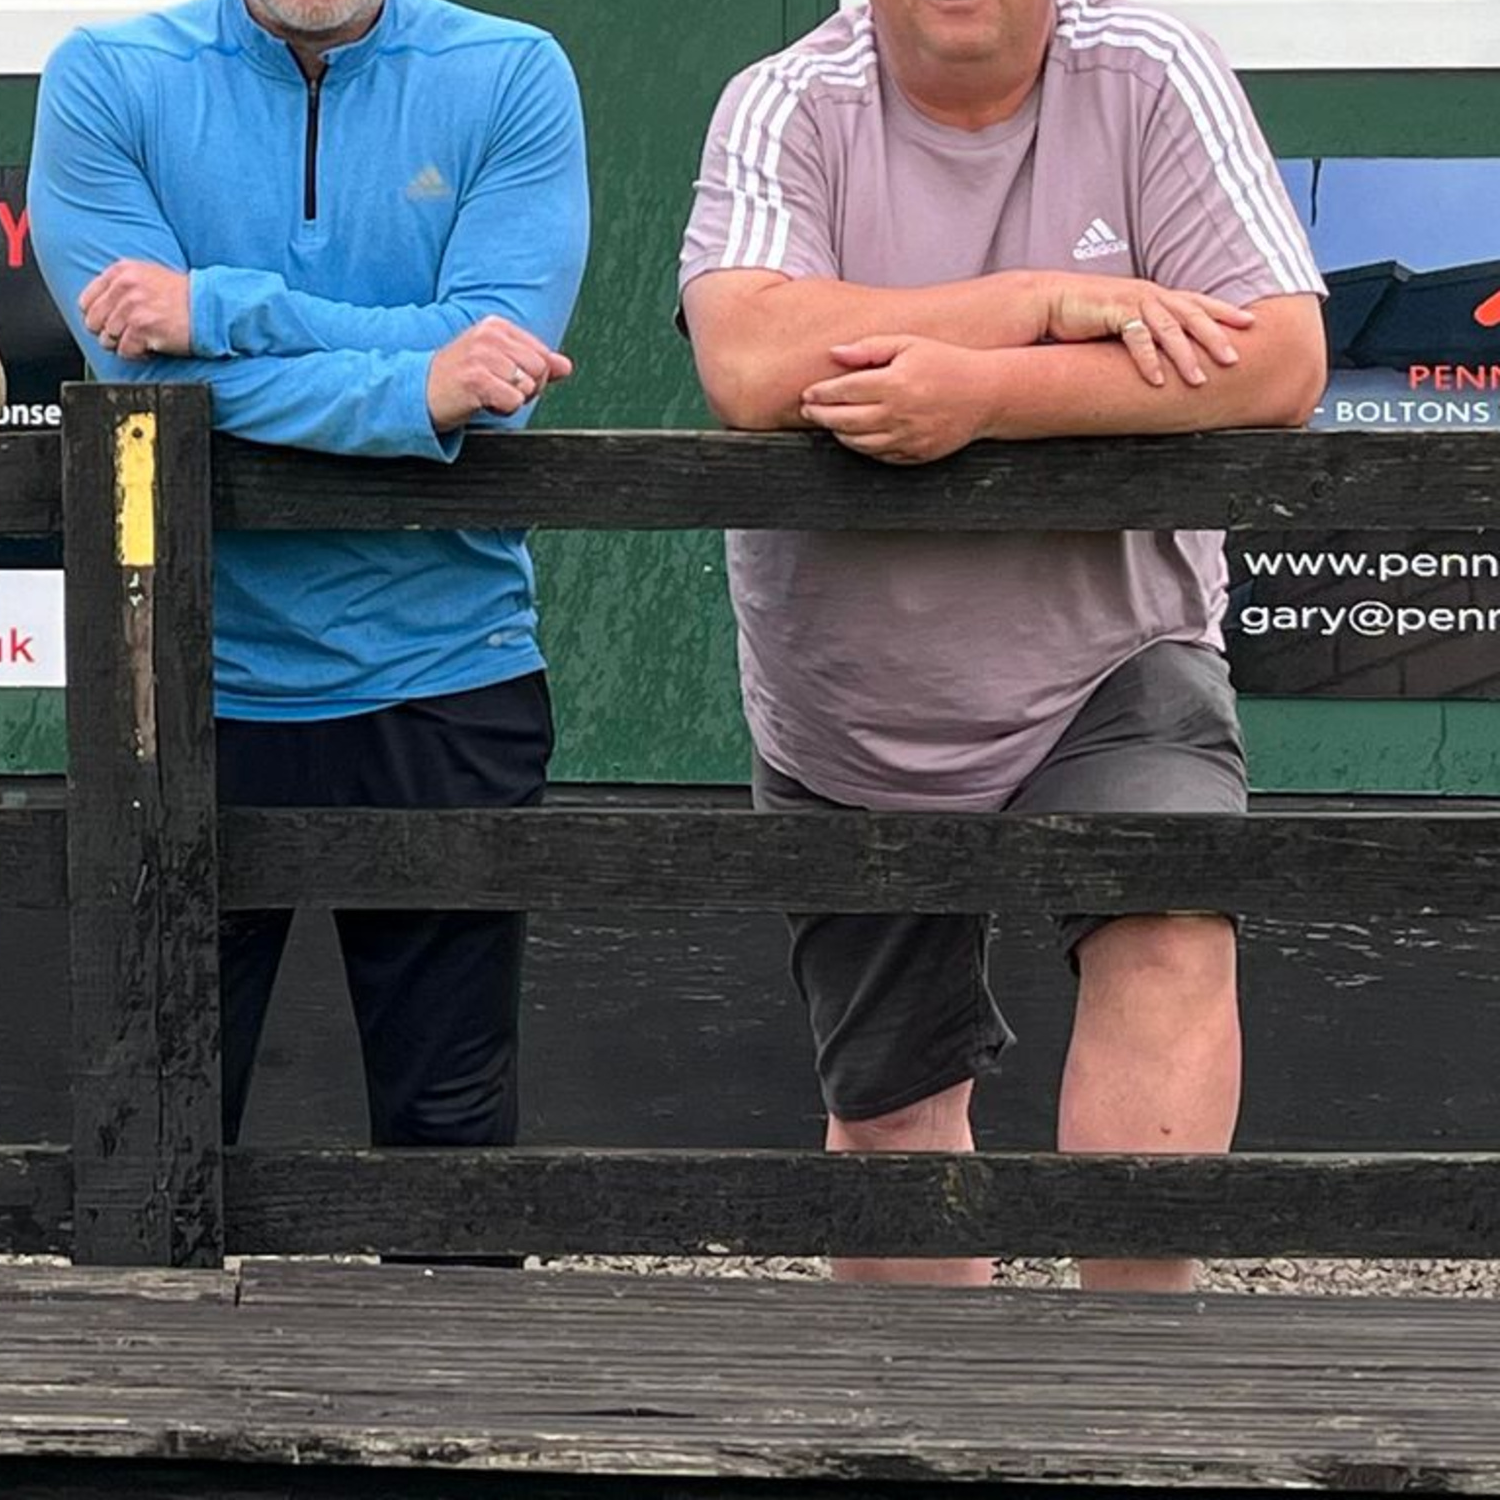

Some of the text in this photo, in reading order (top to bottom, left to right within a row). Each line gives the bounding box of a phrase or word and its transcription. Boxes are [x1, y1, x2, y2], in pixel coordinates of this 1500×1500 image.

[1073, 239, 1128, 260] adidas
[1336, 401, 1491, 423] BOLTONS
[1243, 551, 1499, 581] www.penn
